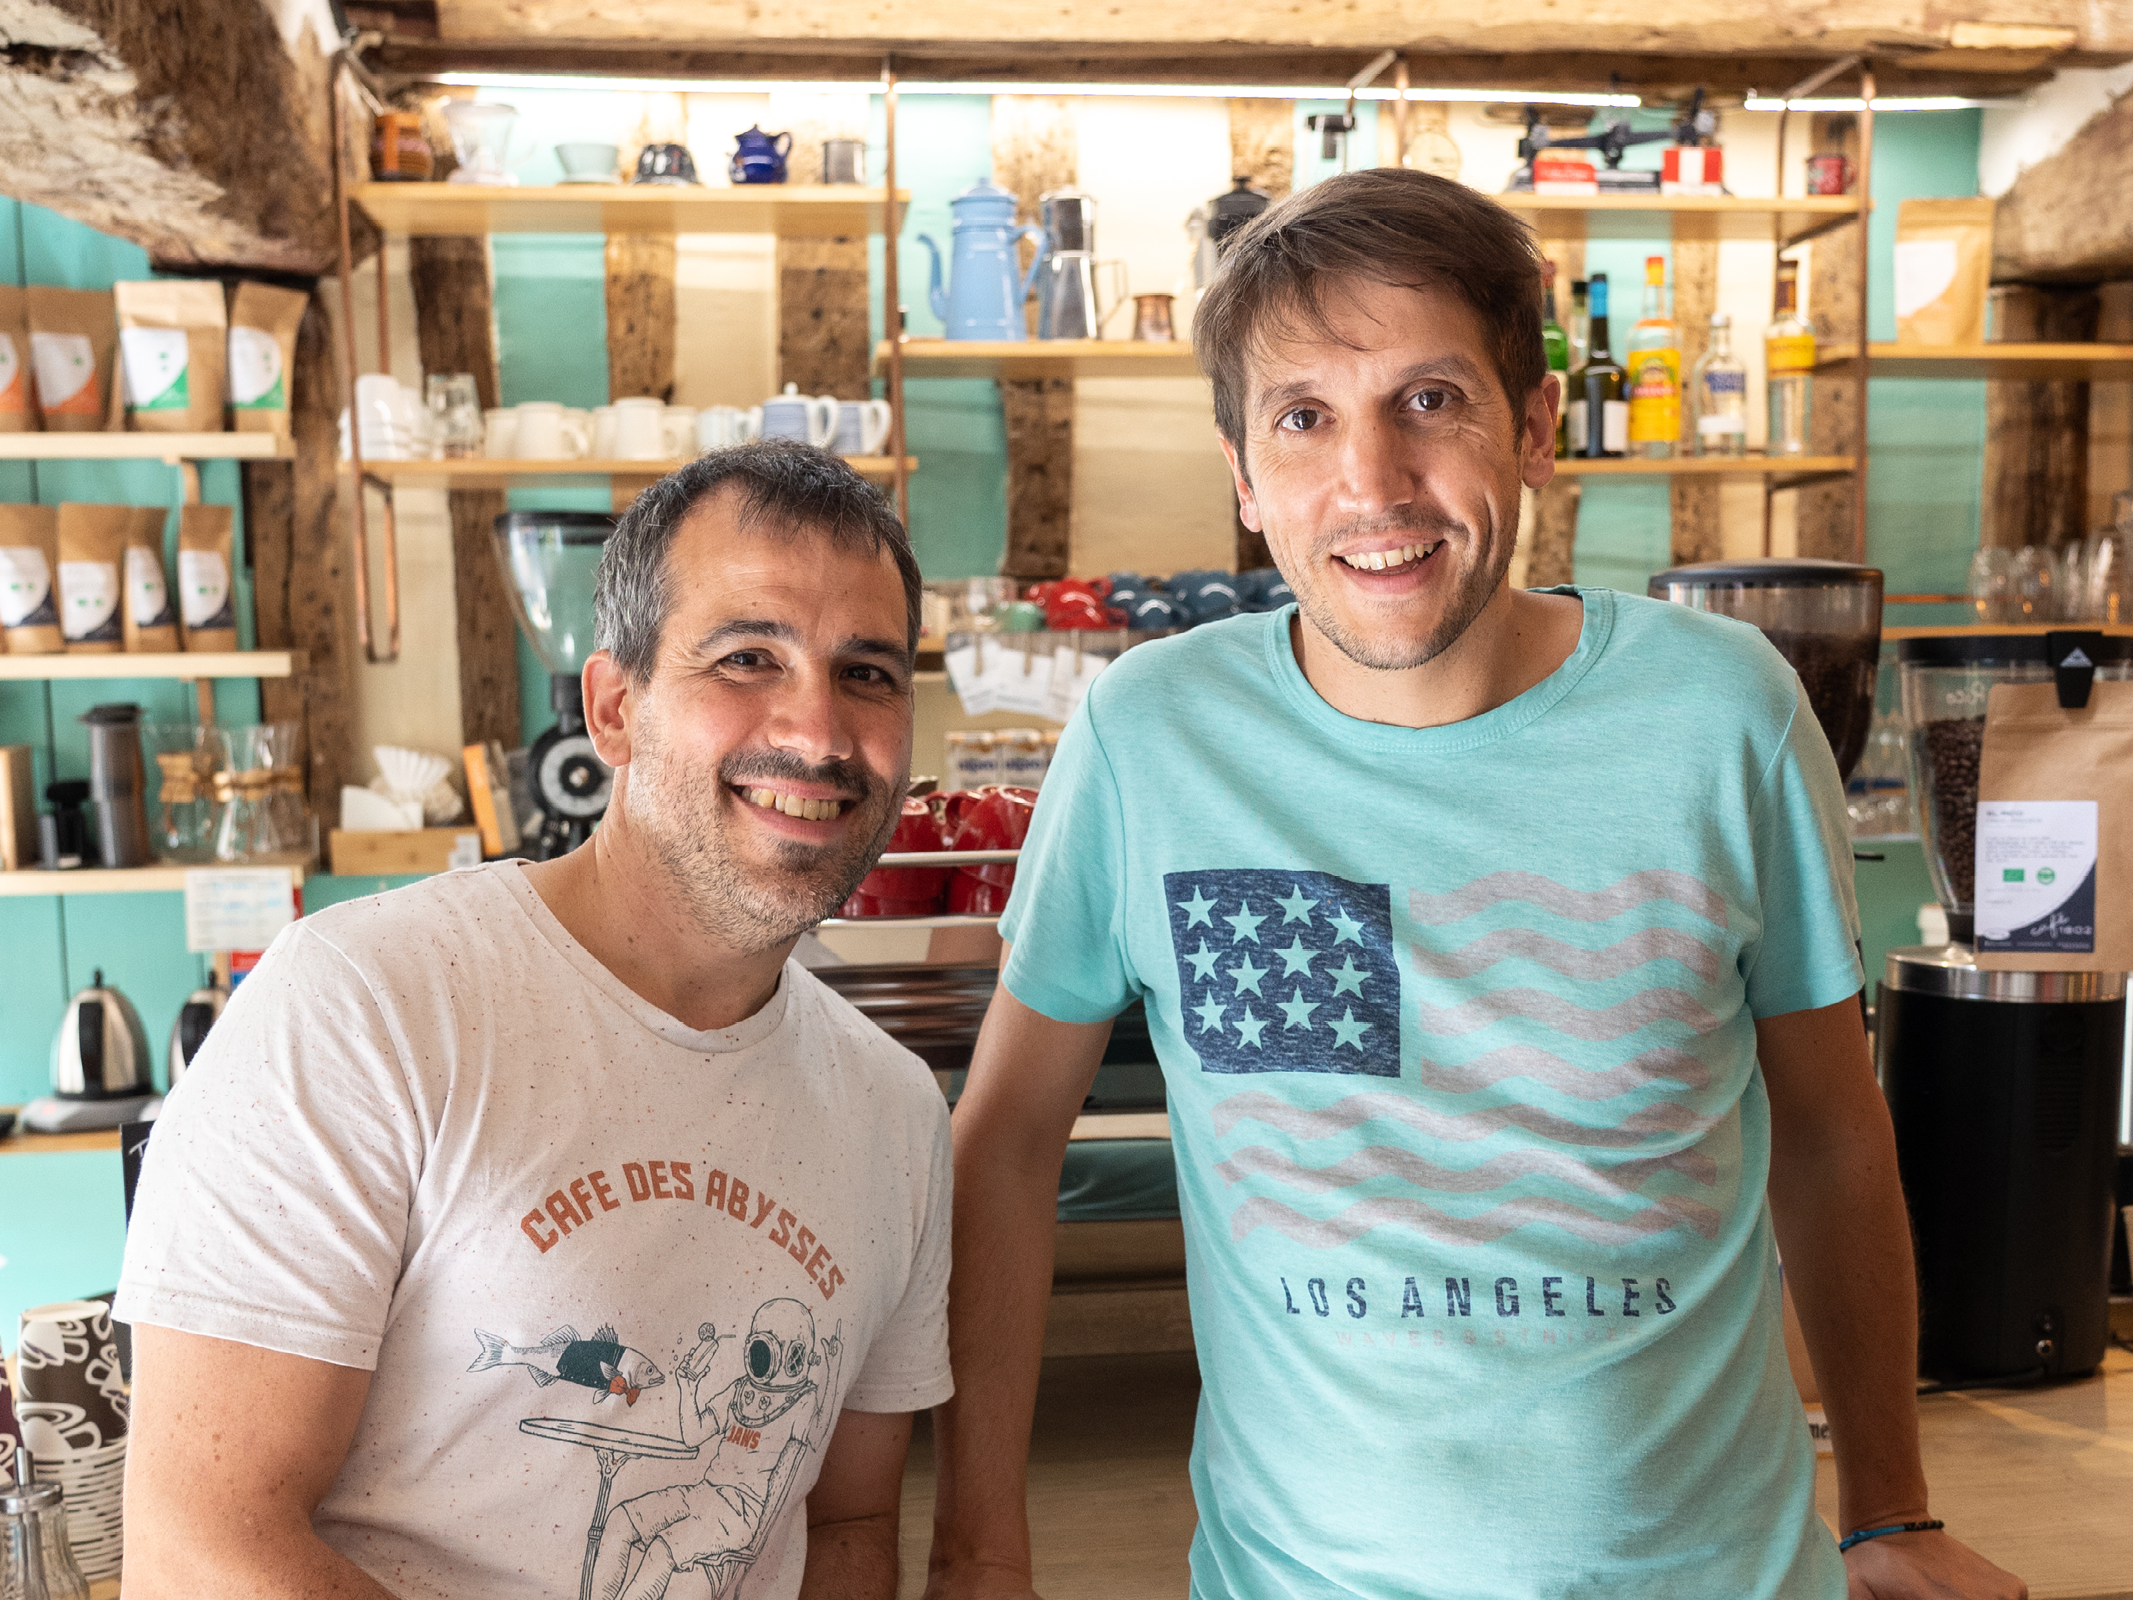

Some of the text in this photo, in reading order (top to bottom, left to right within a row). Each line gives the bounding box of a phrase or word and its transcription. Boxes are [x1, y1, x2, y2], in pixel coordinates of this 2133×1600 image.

[520, 1160, 846, 1301] CAFE DES ABYSSES
[1280, 1275, 1677, 1319] LOS ANGELES
[726, 1424, 761, 1450] JAWS
